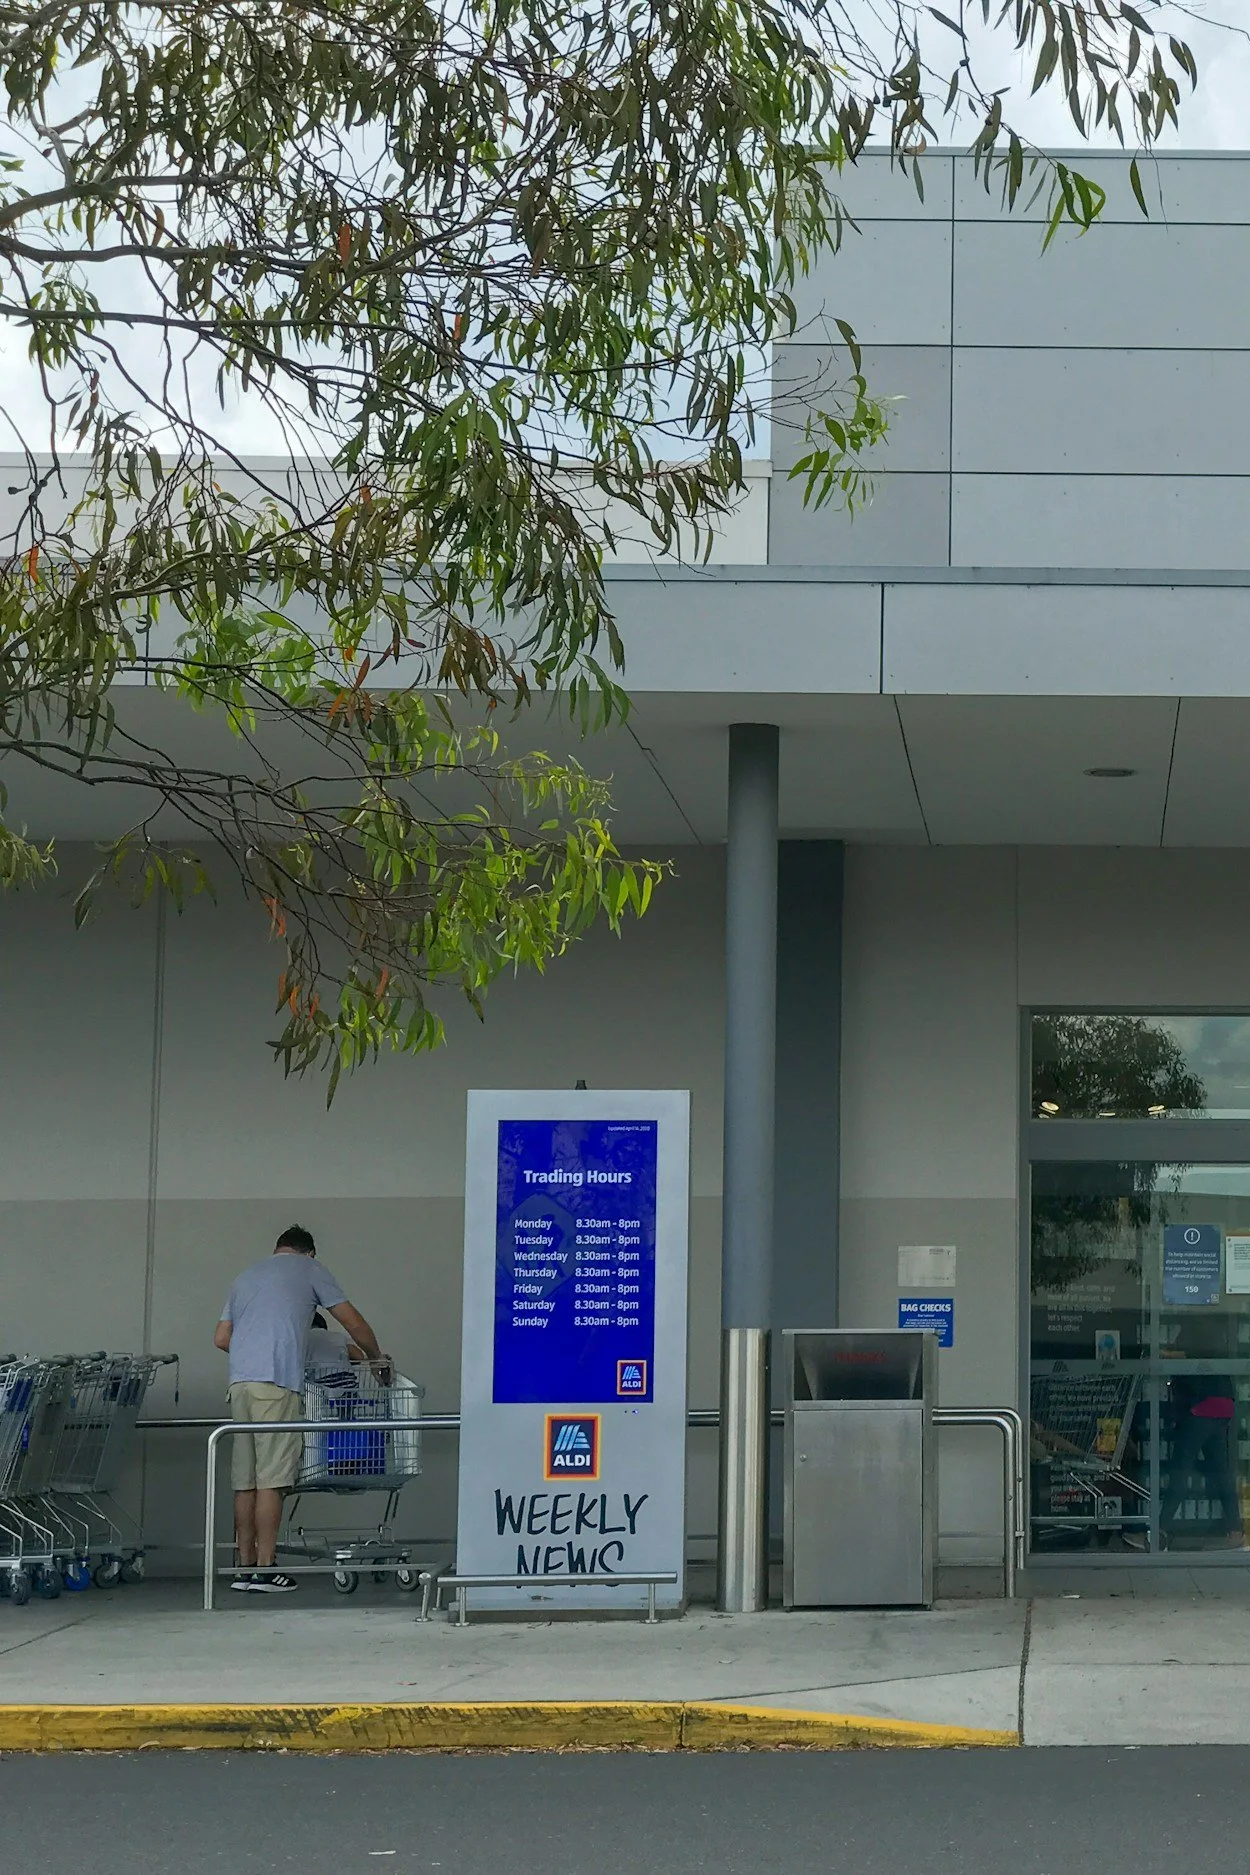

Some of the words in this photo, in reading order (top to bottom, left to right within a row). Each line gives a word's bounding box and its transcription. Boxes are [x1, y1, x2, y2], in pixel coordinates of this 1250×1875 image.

[524, 1169, 583, 1187] Trading
[587, 1169, 632, 1184] Hours
[515, 1219, 552, 1230] Monday
[576, 1219, 610, 1228] 8.30am
[618, 1219, 640, 1230] 8pm
[515, 1235, 554, 1246] Tuesday
[576, 1235, 610, 1244] 8.30am
[618, 1235, 639, 1246] 8pm
[514, 1252, 568, 1263] Wednesday
[576, 1252, 610, 1262] 8.30am
[618, 1252, 639, 1263] 8pm
[514, 1268, 558, 1279] Thursday
[575, 1268, 609, 1278] 8.30am
[618, 1268, 639, 1279] 8pm
[514, 1284, 544, 1295] Friday
[575, 1284, 609, 1294] 8.30am
[618, 1284, 639, 1295] 8pm
[513, 1300, 556, 1311] Saturday
[575, 1300, 609, 1310] 8.30am
[617, 1300, 638, 1311] 8pm
[900, 1304, 918, 1312] BAG
[919, 1304, 951, 1312] CHECKS
[513, 1317, 548, 1328] Sunday
[574, 1317, 608, 1326] 8.30am
[617, 1317, 638, 1328] 8pm
[622, 1380, 641, 1388] ALDI
[553, 1454, 590, 1466] ALDI
[494, 1489, 649, 1535] WEEKLY
[517, 1540, 624, 1588] NEWS
